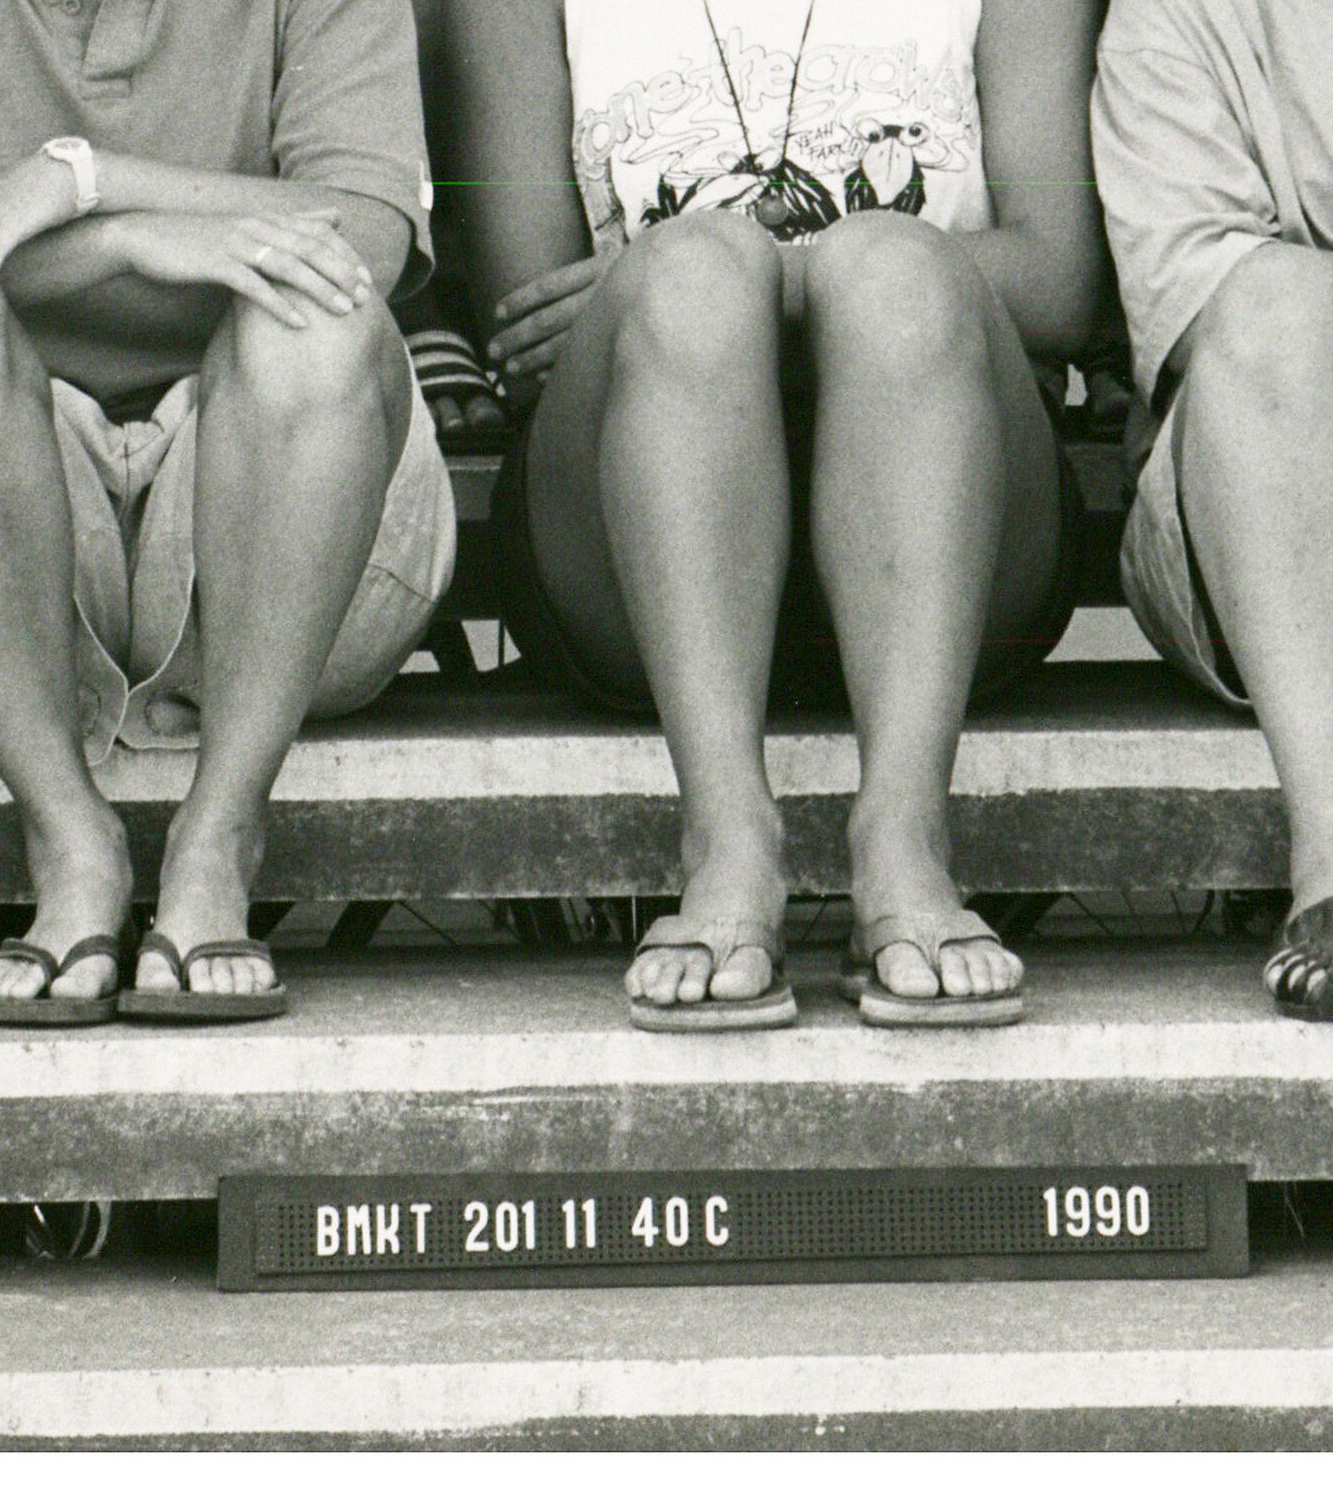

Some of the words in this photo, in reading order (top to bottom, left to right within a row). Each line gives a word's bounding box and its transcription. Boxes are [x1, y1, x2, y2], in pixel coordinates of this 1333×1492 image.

[688, 25, 797, 113] the
[315, 1202, 433, 1257] BMKT
[462, 1199, 537, 1253] 201
[560, 1197, 597, 1250] 11
[1042, 1184, 1151, 1238] 1990
